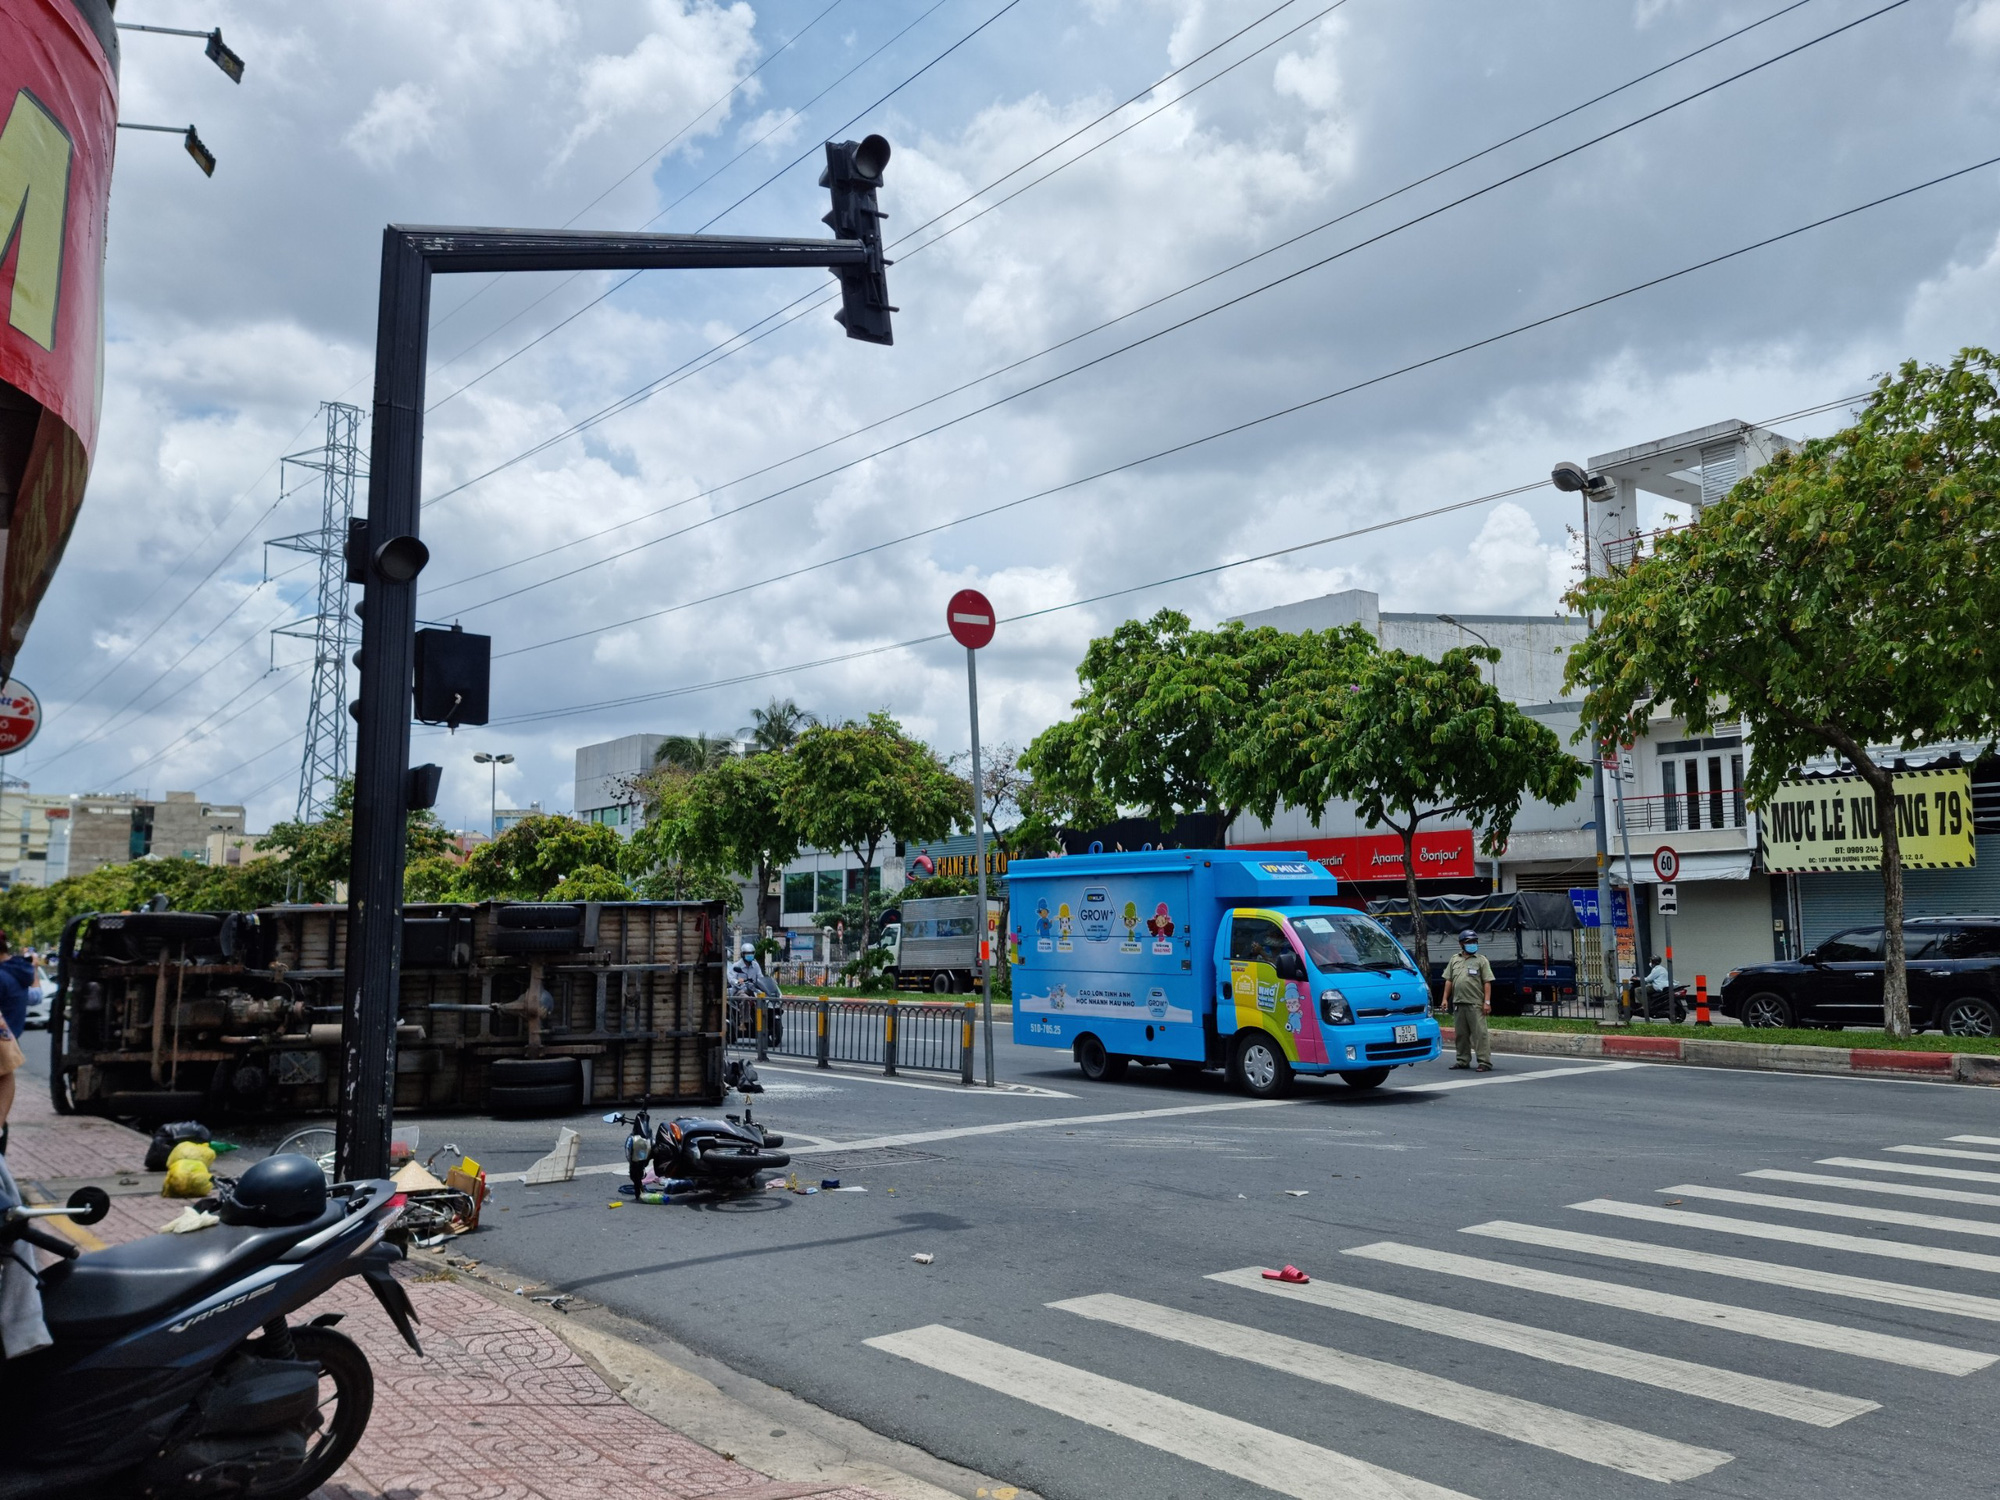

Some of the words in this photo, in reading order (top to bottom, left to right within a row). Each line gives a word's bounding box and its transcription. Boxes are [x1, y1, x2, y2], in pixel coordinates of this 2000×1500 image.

[1821, 789, 1846, 841] LÉ
[1934, 791, 1962, 836] 79
[1420, 847, 1458, 865] Bonjour
[1846, 846, 1864, 854] 0909
[1865, 845, 1879, 853] 244
[937, 855, 964, 876] CHANG
[968, 853, 991, 875] KAG
[1660, 856, 1672, 871] 60
